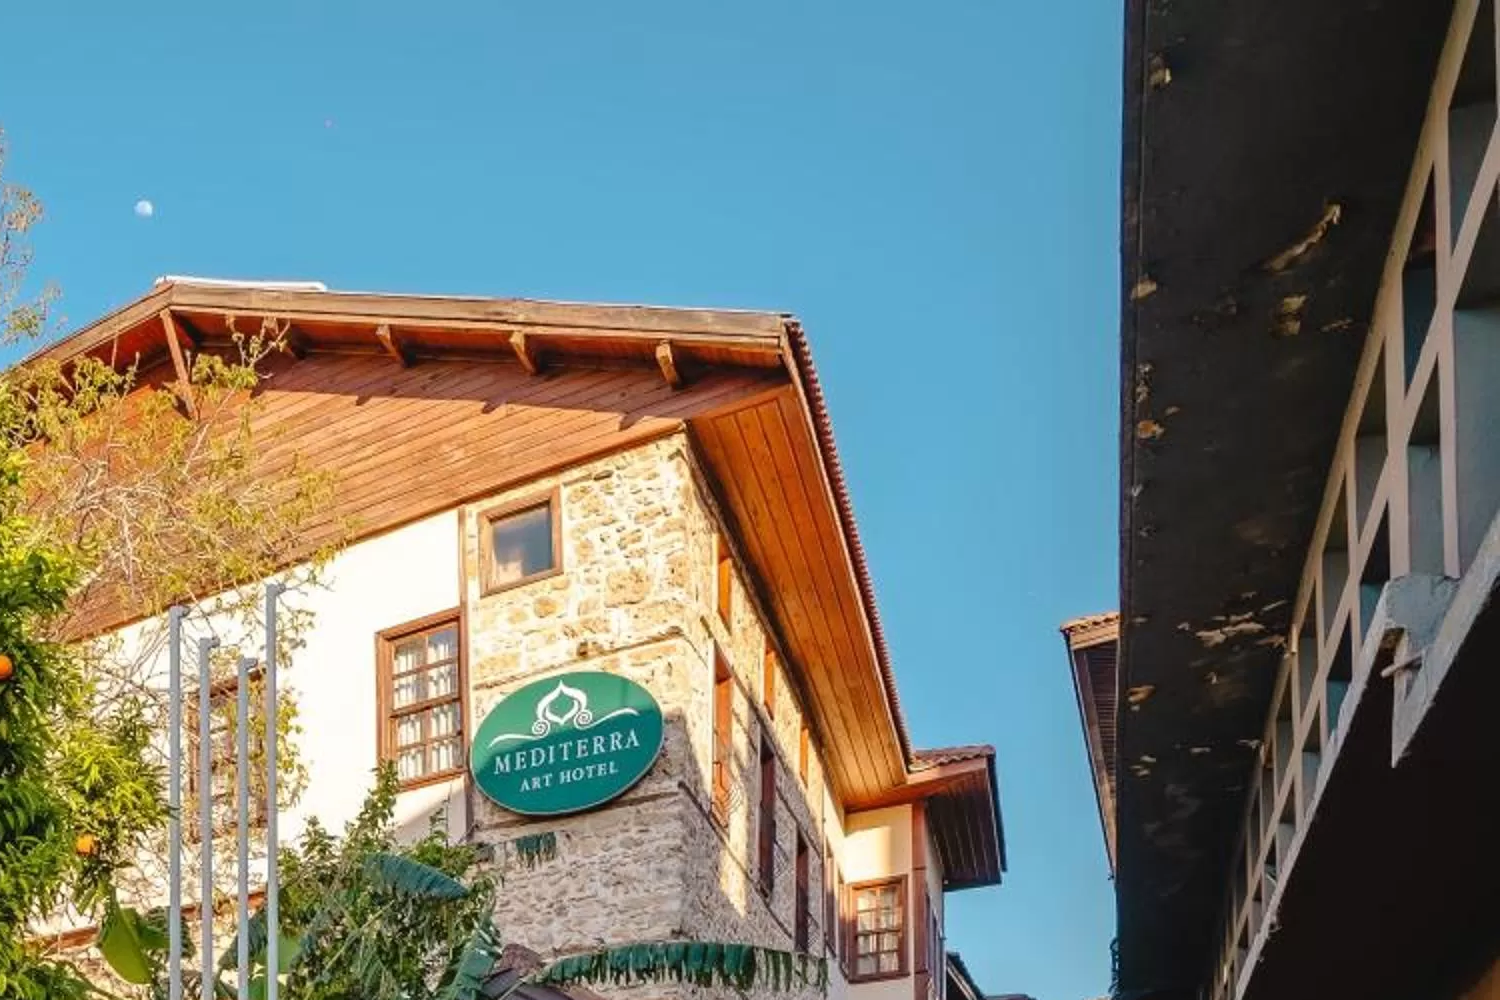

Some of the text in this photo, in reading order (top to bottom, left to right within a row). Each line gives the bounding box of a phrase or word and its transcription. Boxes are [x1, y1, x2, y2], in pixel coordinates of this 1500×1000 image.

[493, 728, 641, 776] MEDITERRA
[519, 761, 619, 793] ART HOTEL
